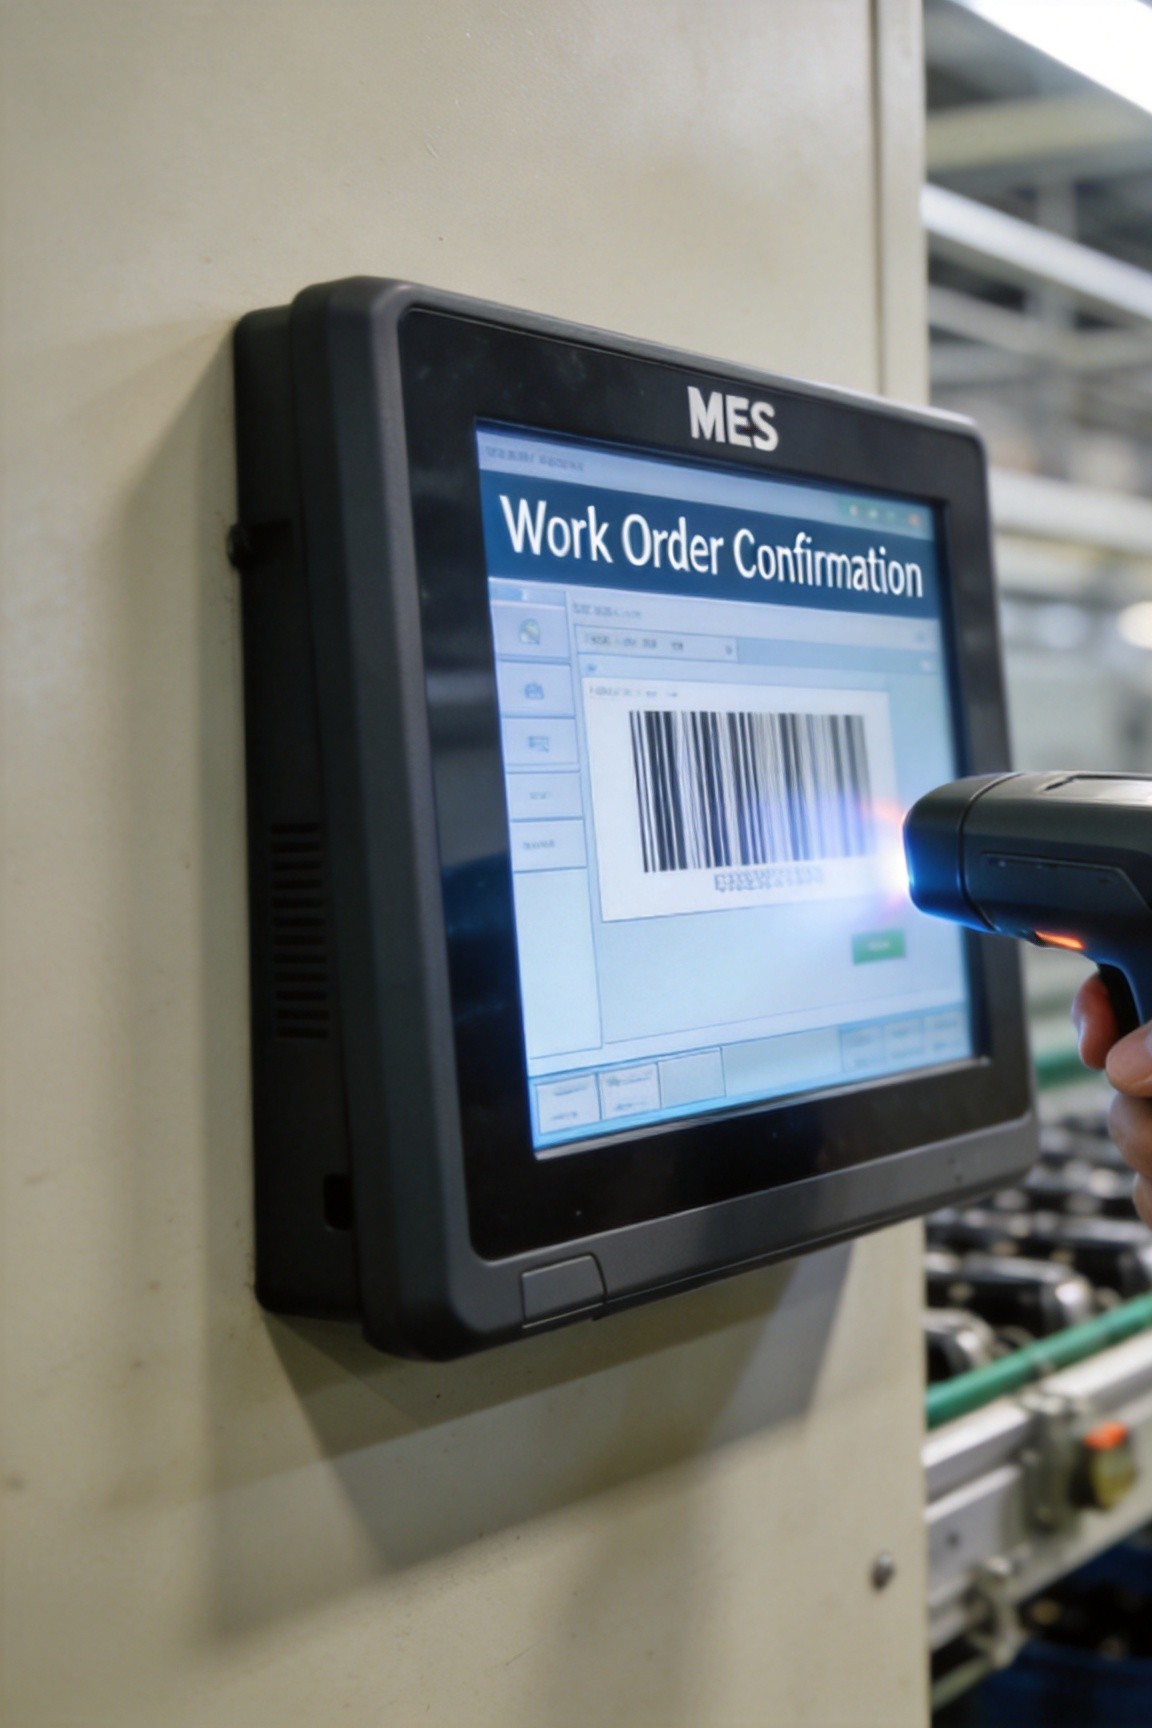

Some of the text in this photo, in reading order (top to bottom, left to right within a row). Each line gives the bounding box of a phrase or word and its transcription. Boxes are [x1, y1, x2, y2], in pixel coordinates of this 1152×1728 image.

[687, 386, 780, 452] MES
[500, 495, 923, 598] Work Order Confirmation
